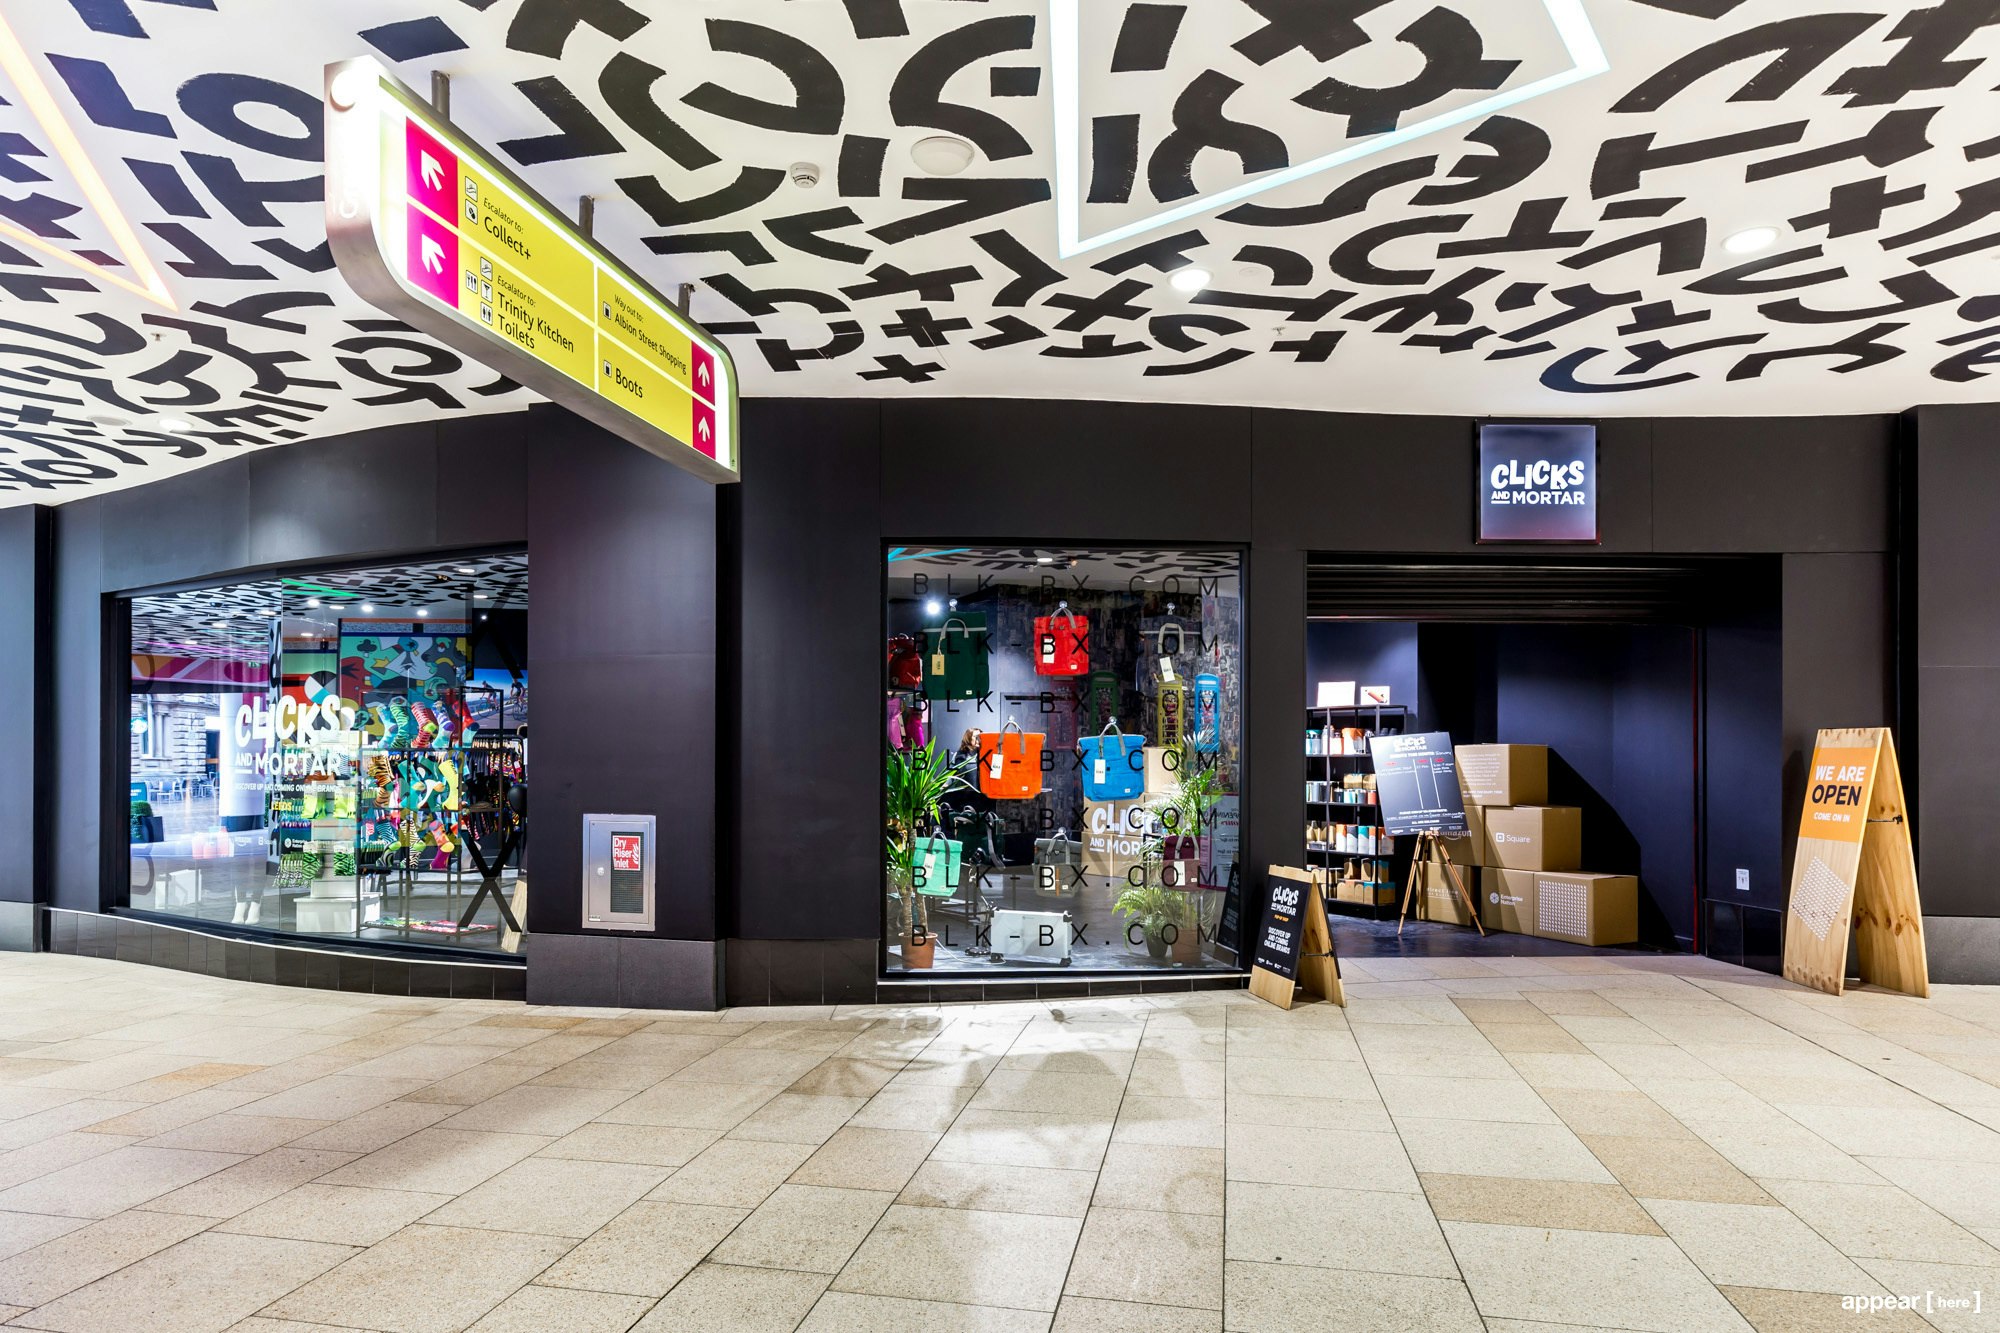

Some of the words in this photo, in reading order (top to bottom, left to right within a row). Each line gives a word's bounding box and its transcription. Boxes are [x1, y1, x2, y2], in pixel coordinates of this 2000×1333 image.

[483, 198, 514, 226] Escalator
[515, 221, 524, 234] to:
[484, 216, 532, 260] Collect+
[497, 275, 527, 300] Escalator
[527, 294, 536, 308] to:
[614, 294, 626, 311] Way
[627, 304, 636, 318] out
[636, 311, 644, 323] to:
[497, 292, 534, 331] Trinity
[537, 317, 574, 353] Kitchen
[498, 313, 535, 349] Toilets
[614, 313, 637, 338] Albion
[638, 329, 658, 352] Street
[659, 344, 687, 376] Shopping
[615, 367, 643, 398] Boots
[1490, 459, 1585, 490] CLICKS
[1491, 490, 1511, 500] AND
[1512, 491, 1586, 505] MORTAR
[234, 694, 341, 749] CLICKS
[234, 752, 253, 767] AND
[255, 751, 342, 777] MORTAR
[1815, 765, 1835, 781] WE
[1836, 765, 1867, 782] ARE
[274, 784, 295, 792] COMING
[1811, 784, 1862, 806] OPEN
[271, 801, 292, 811] LEEDS
[1813, 811, 1832, 821] COME
[1833, 812, 1842, 822] ON
[1842, 813, 1850, 823] IN
[614, 837, 627, 849] Dry
[1090, 837, 1105, 848] AND
[1107, 839, 1142, 856] MOR
[1506, 834, 1531, 843] Square
[614, 848, 632, 858] Riser
[614, 857, 629, 868] Inlet
[1272, 885, 1299, 906] CLICKS
[1276, 902, 1297, 916] MORTAR
[1285, 932, 1292, 940] UP
